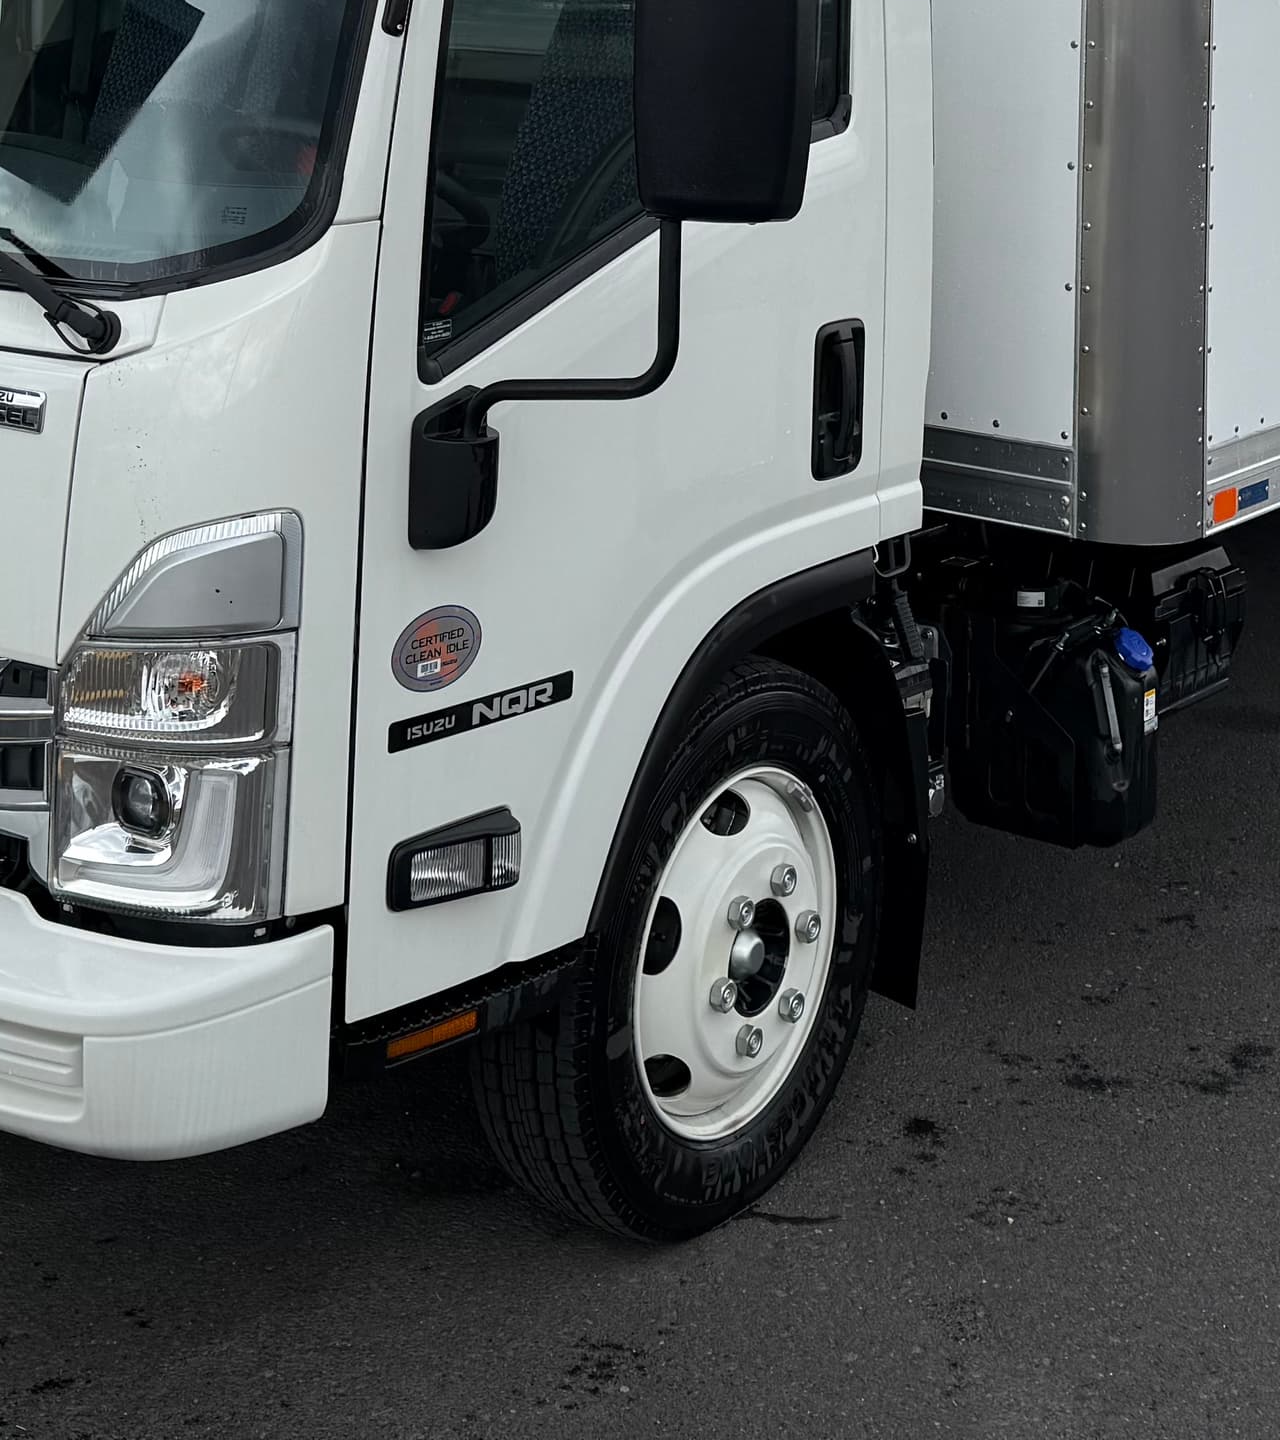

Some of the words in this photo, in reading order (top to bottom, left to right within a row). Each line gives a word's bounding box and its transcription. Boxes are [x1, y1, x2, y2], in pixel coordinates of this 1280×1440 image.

[411, 627, 464, 650] CERTIFIED
[405, 646, 442, 665] CLEAN
[447, 640, 470, 655] IDLE
[407, 714, 456, 740] ISUZU
[472, 682, 554, 726] NQR
